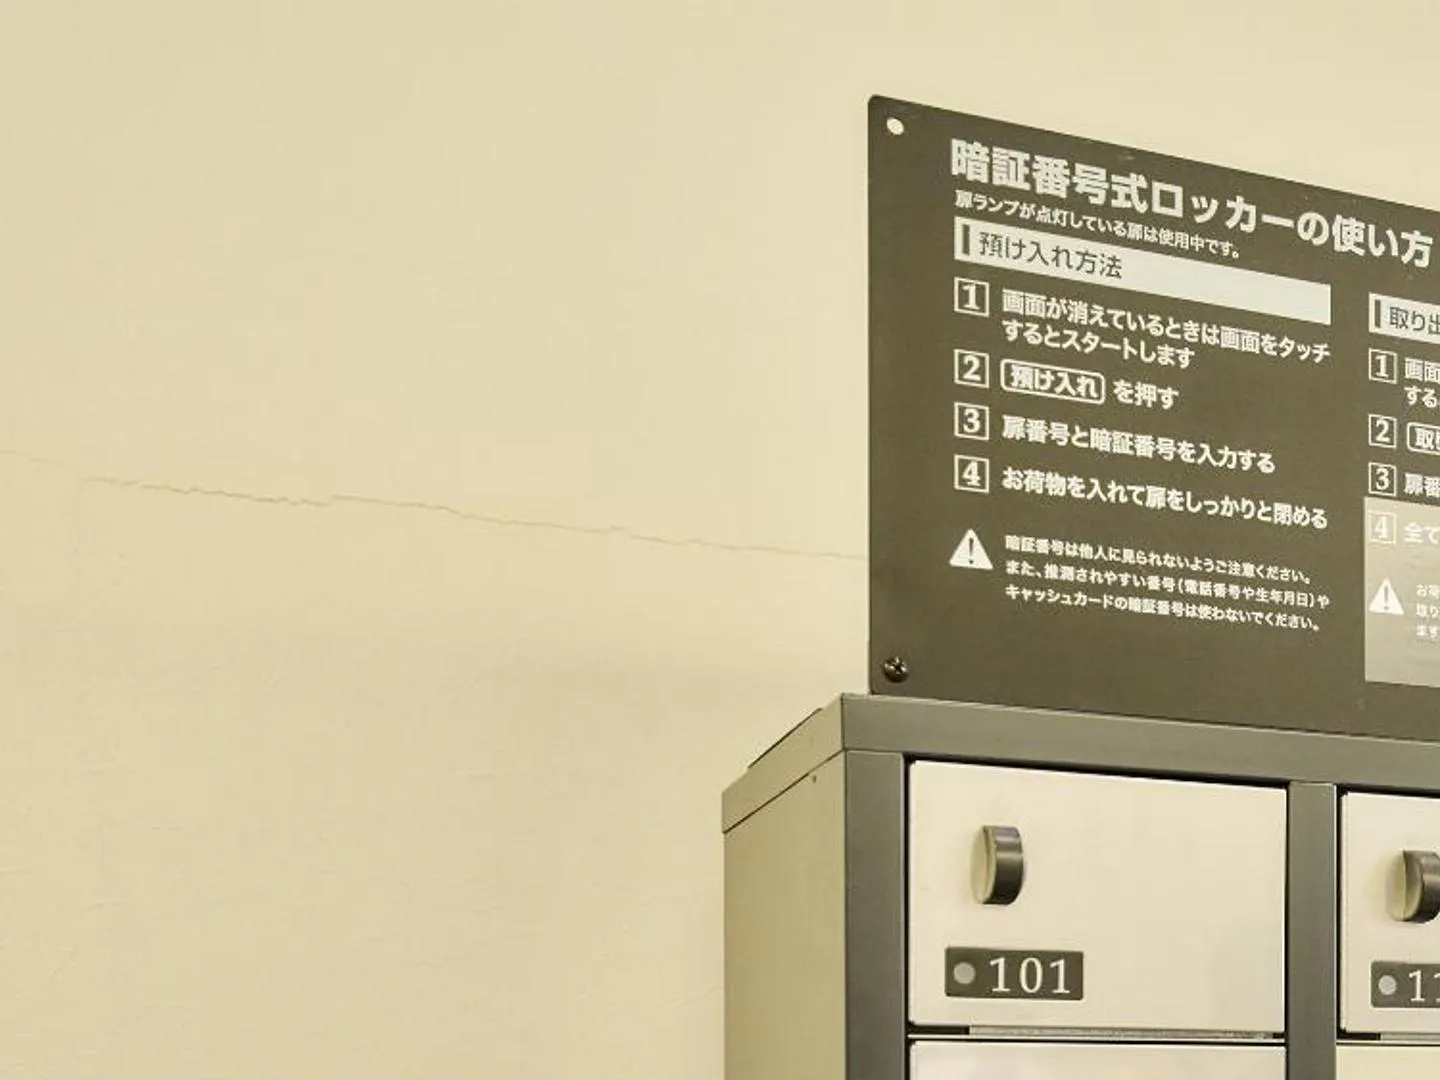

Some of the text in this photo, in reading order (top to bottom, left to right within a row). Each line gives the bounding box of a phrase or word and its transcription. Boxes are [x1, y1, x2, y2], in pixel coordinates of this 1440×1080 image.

[950, 138, 1434, 268] 暗証番号式ロッカーの使い方
[954, 190, 1240, 259] 扉ランプが点灯している扉は使用中です。
[977, 232, 1122, 280] 預け入れ方法
[1002, 289, 1330, 364] 画面が消えているときは画面をタッチ
[1003, 319, 1195, 370] するとスタートします
[1009, 362, 1099, 400] 預け入れ
[1113, 377, 1179, 410] を押す
[1002, 414, 1275, 474] 扉番号と暗証番号を入力する
[1002, 466, 1328, 530] お荷物を入れて扉をしっかりと閉める
[1005, 534, 1311, 585] 暗証番号は他人に見られないようご注意ください。
[989, 957, 1071, 994] 101
